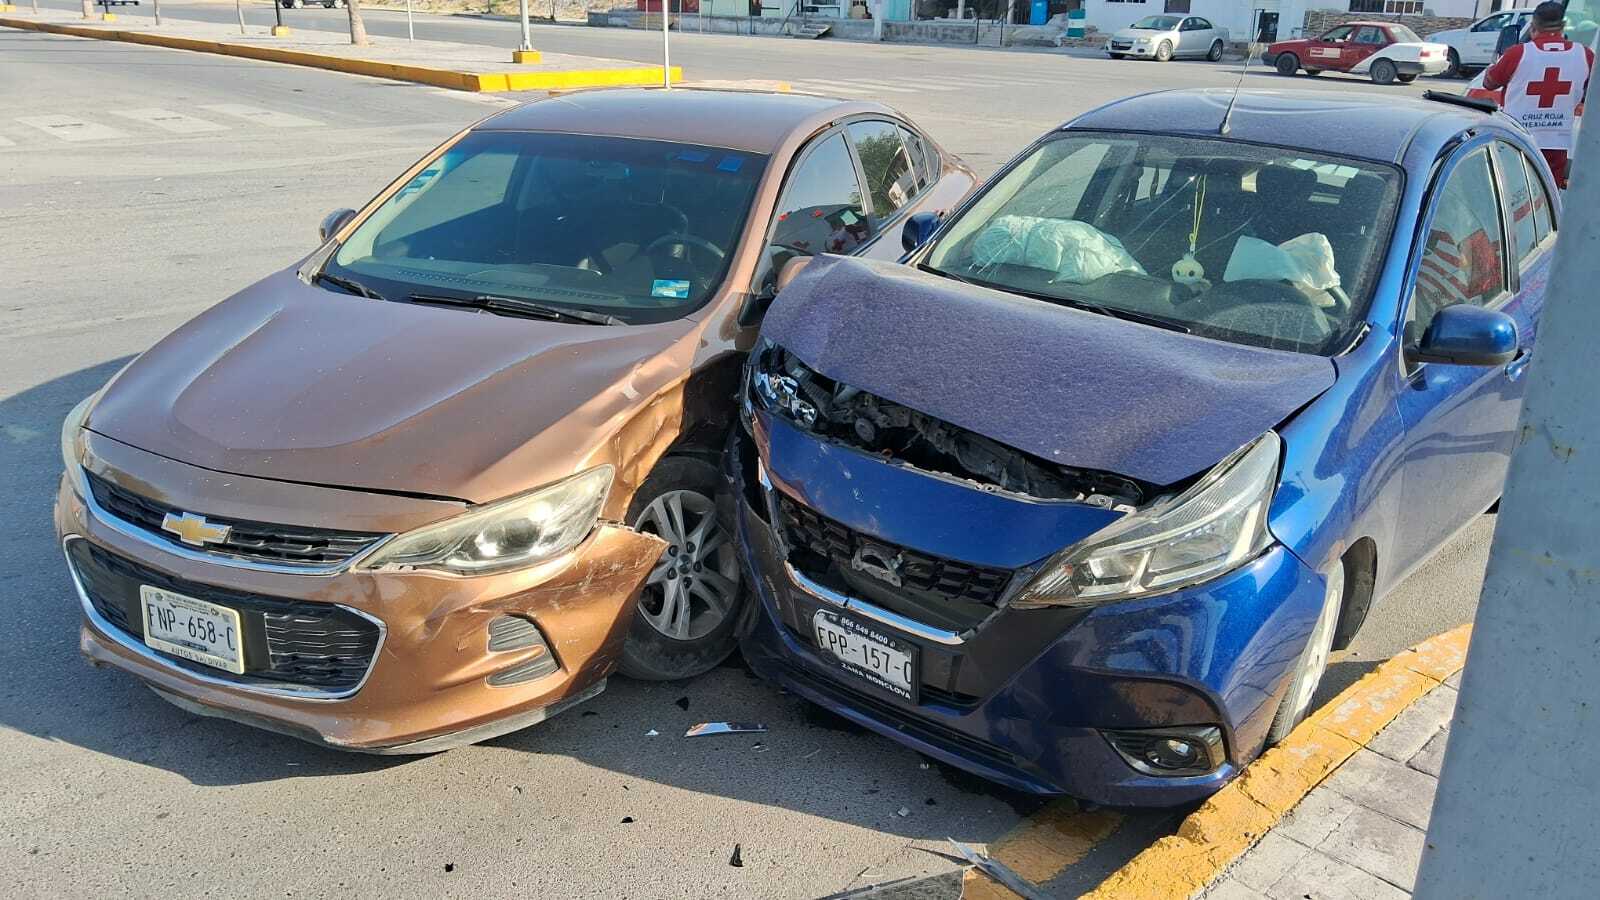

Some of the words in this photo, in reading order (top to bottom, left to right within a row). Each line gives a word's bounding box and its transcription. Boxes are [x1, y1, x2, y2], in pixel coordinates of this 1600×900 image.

[1522, 113, 1543, 121] CRUZ
[1545, 112, 1564, 120] ROJA
[147, 603, 236, 652] FNP-658-C
[841, 617, 854, 628] 866
[171, 647, 193, 660] AUTOS
[841, 663, 864, 677] ZAMA
[866, 673, 912, 700] MONCLOVA
